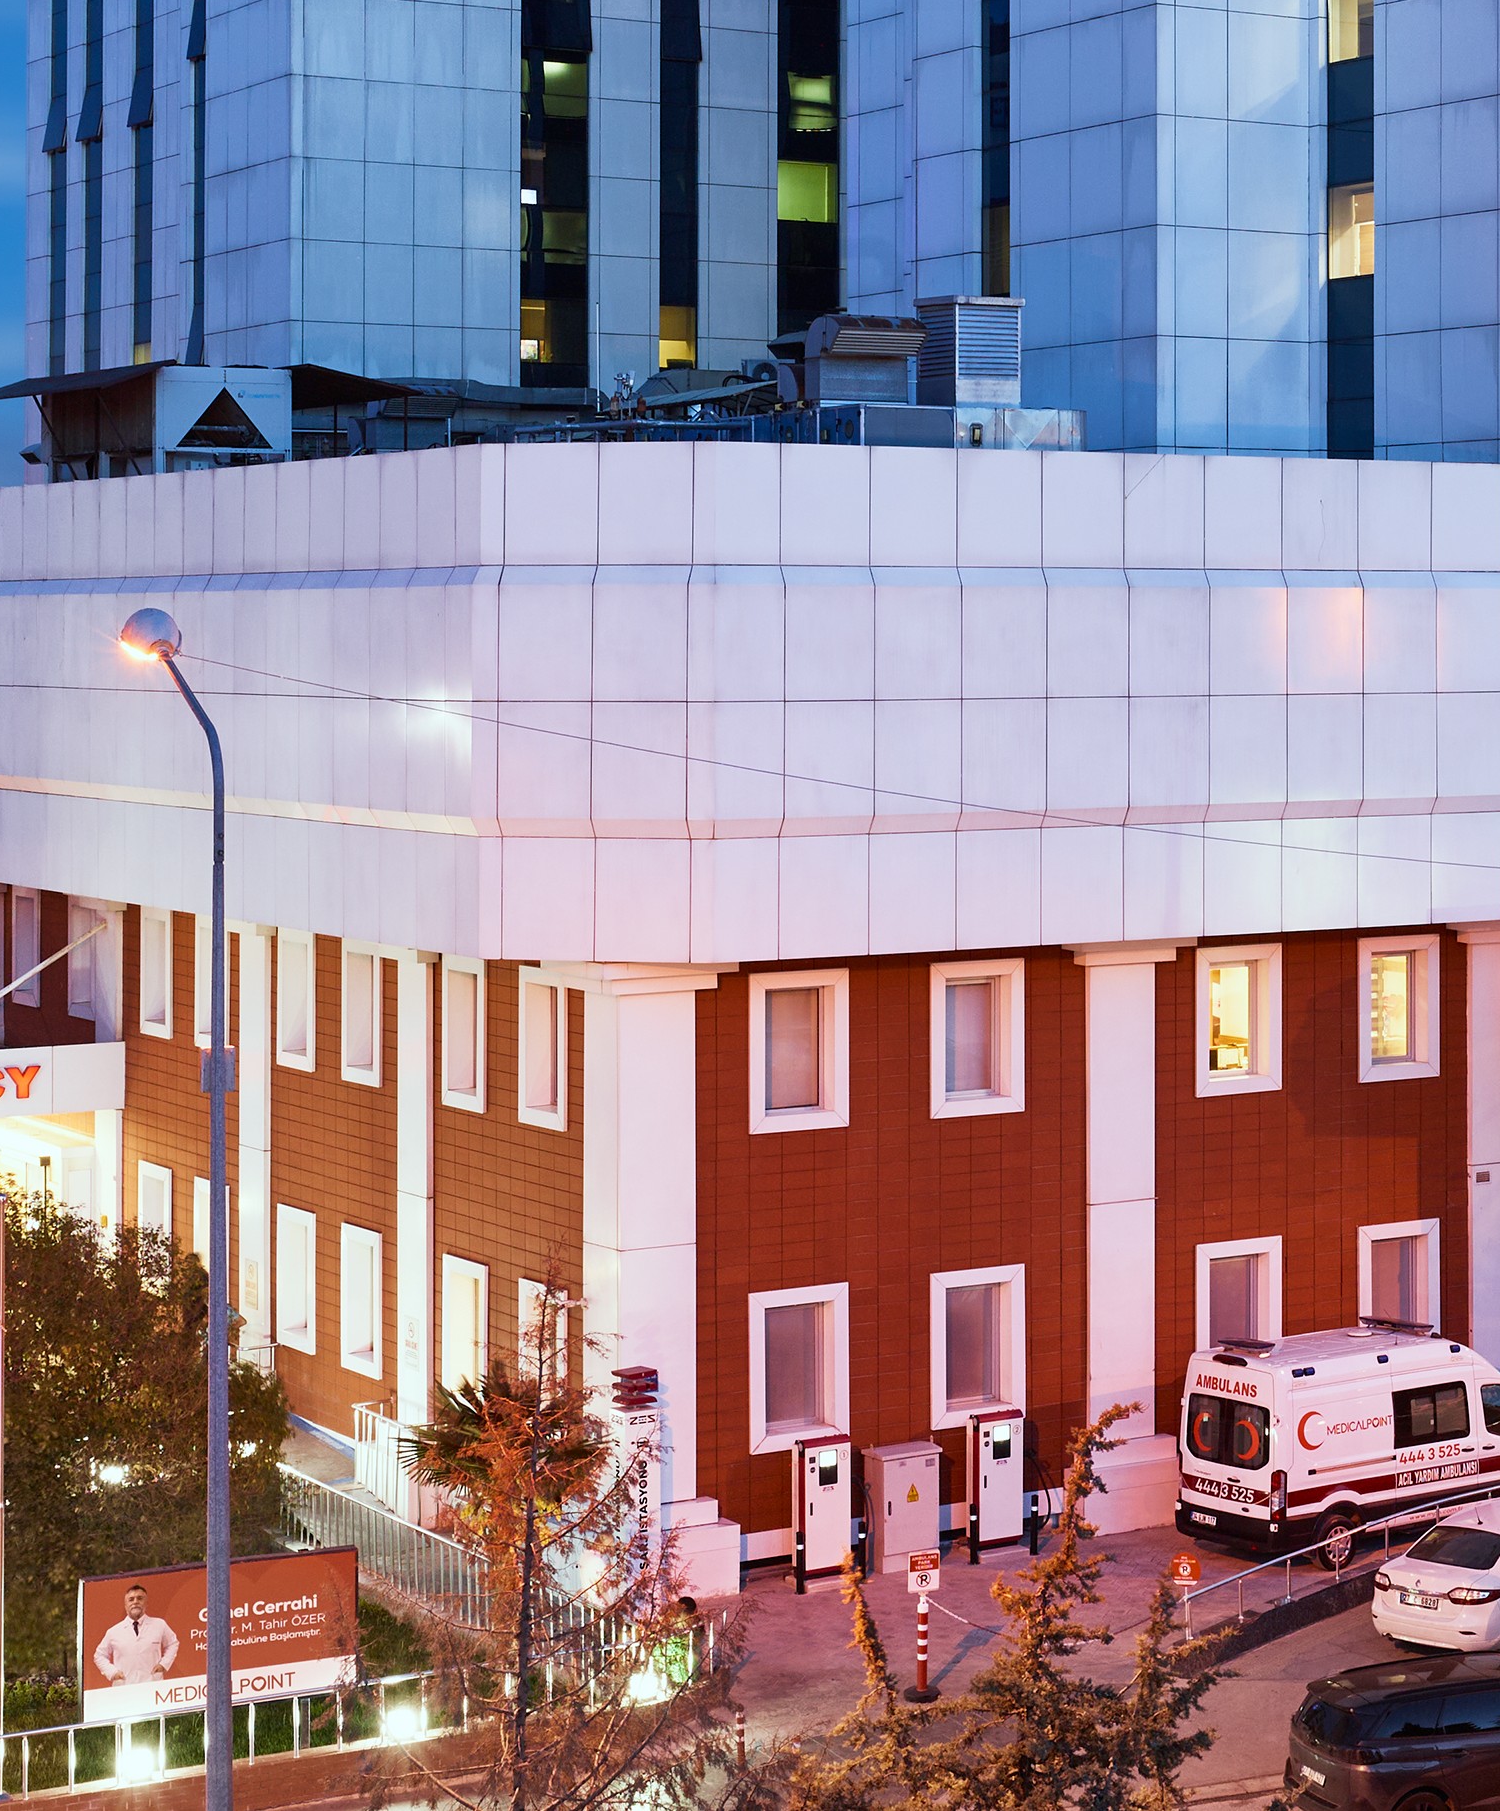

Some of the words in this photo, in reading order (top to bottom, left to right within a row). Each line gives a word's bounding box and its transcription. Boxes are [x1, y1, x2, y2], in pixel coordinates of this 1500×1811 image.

[1196, 1374, 1257, 1398] AMBULANS
[1326, 1415, 1392, 1436] MEDICALPOINT
[1400, 1451, 1424, 1465] 444
[1428, 1447, 1435, 1460] 3
[1438, 1443, 1460, 1459] 525
[1195, 1478, 1219, 1495] 444
[1221, 1484, 1229, 1498] 3
[1231, 1486, 1254, 1503] 525
[252, 1594, 318, 1615] Cerrahi
[242, 1622, 255, 1633] M.
[260, 1618, 288, 1630] Tahir
[291, 1613, 326, 1627] ÖZER
[230, 1636, 268, 1646] abulüne
[269, 1627, 322, 1644] Başlamıştır.
[155, 1672, 296, 1705] MEDILPOINT
